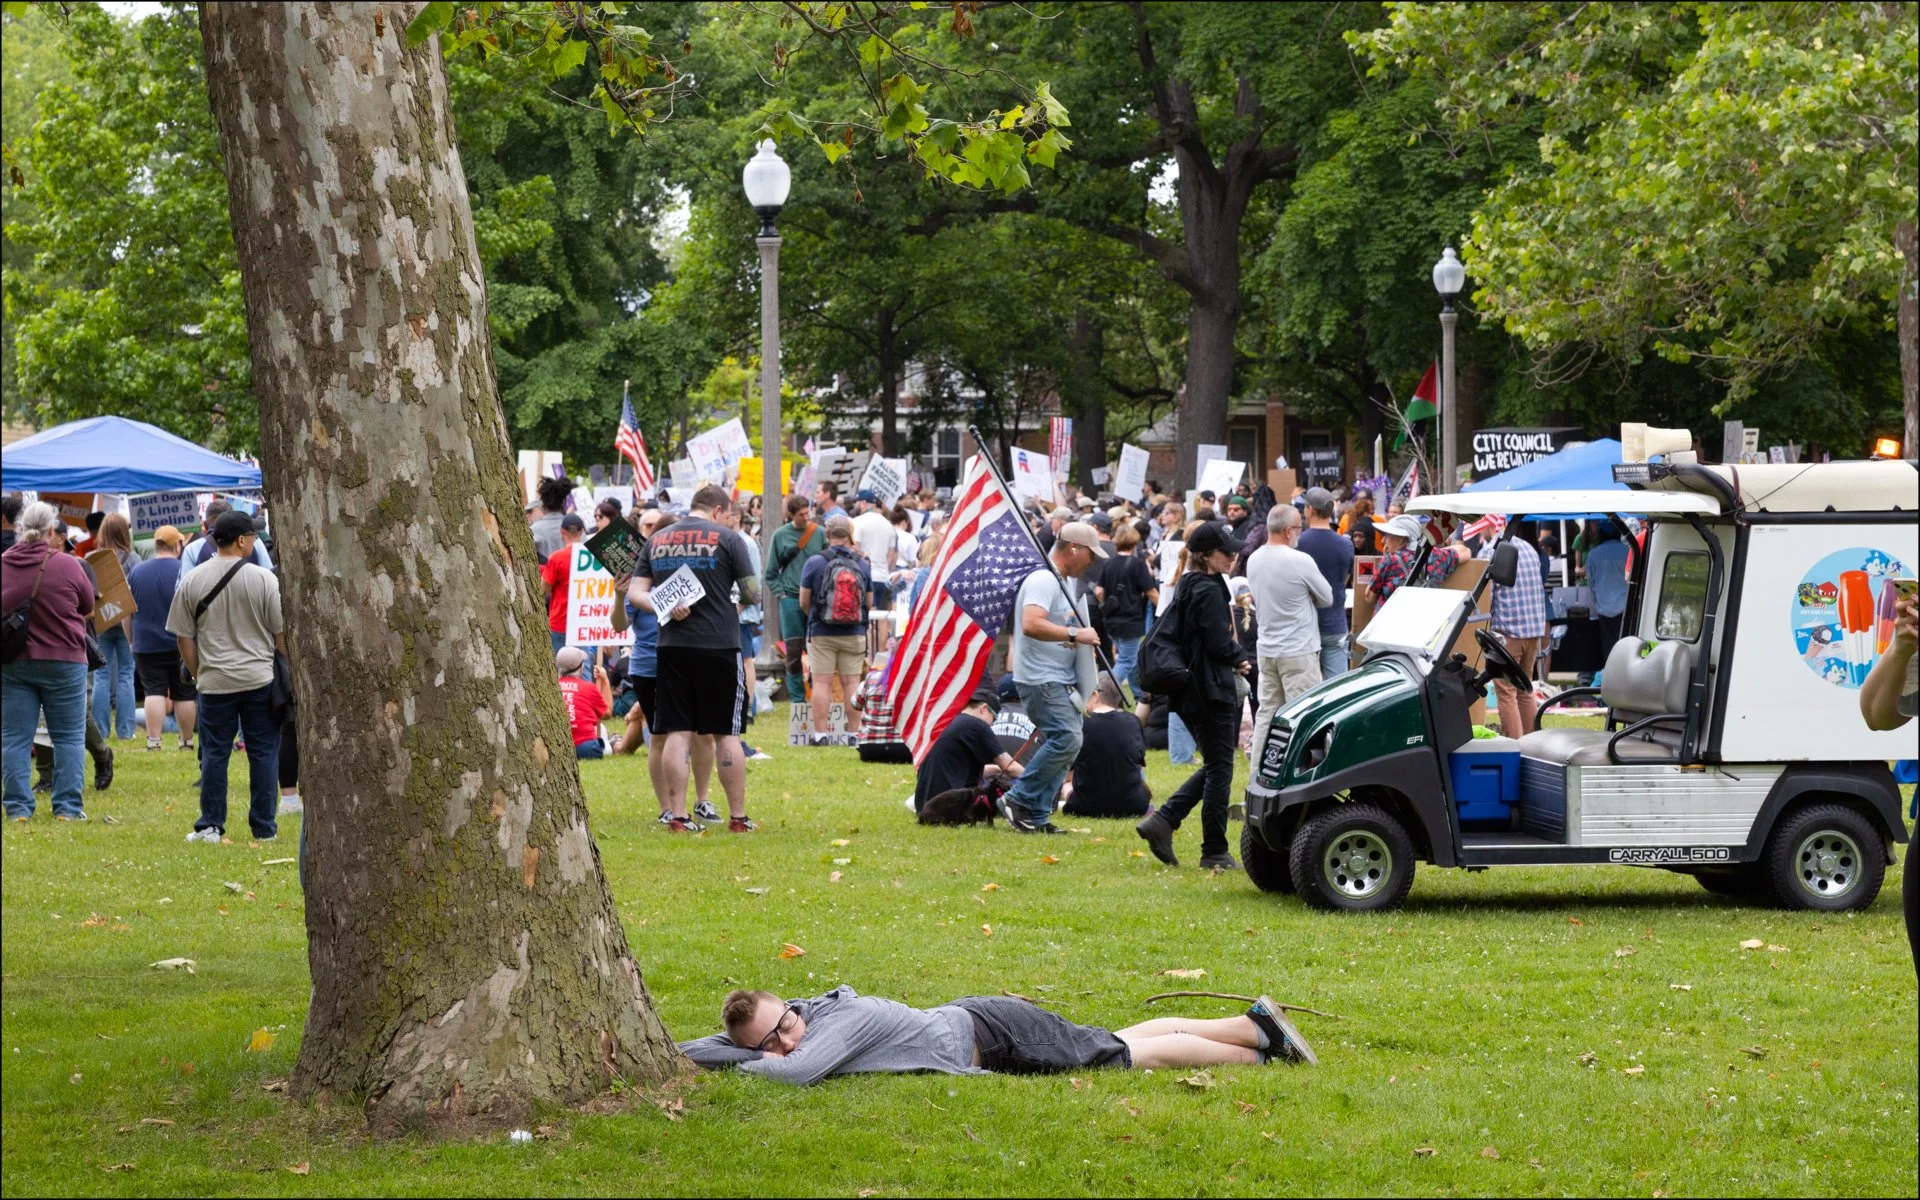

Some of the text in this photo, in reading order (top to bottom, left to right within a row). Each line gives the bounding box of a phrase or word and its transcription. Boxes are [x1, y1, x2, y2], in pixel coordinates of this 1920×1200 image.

[1472, 433, 1555, 453] CITY COUNCIL
[1510, 451, 1549, 467] WATCH
[1304, 467, 1318, 476] TE
[131, 491, 194, 507] Shut Down
[148, 505, 180, 516] Line
[184, 501, 192, 512] 5
[137, 514, 195, 531] Pipeline
[653, 529, 720, 547] HUSTLE
[650, 543, 719, 560] LOYALTY
[652, 556, 719, 571] RESPECT
[573, 577, 615, 599] TRU
[651, 578, 681, 604] LIBERTY
[678, 574, 686, 583] &
[578, 604, 616, 617] ENOU
[1406, 735, 1424, 745] EFI
[1609, 847, 1729, 862] CARRYALL 500
